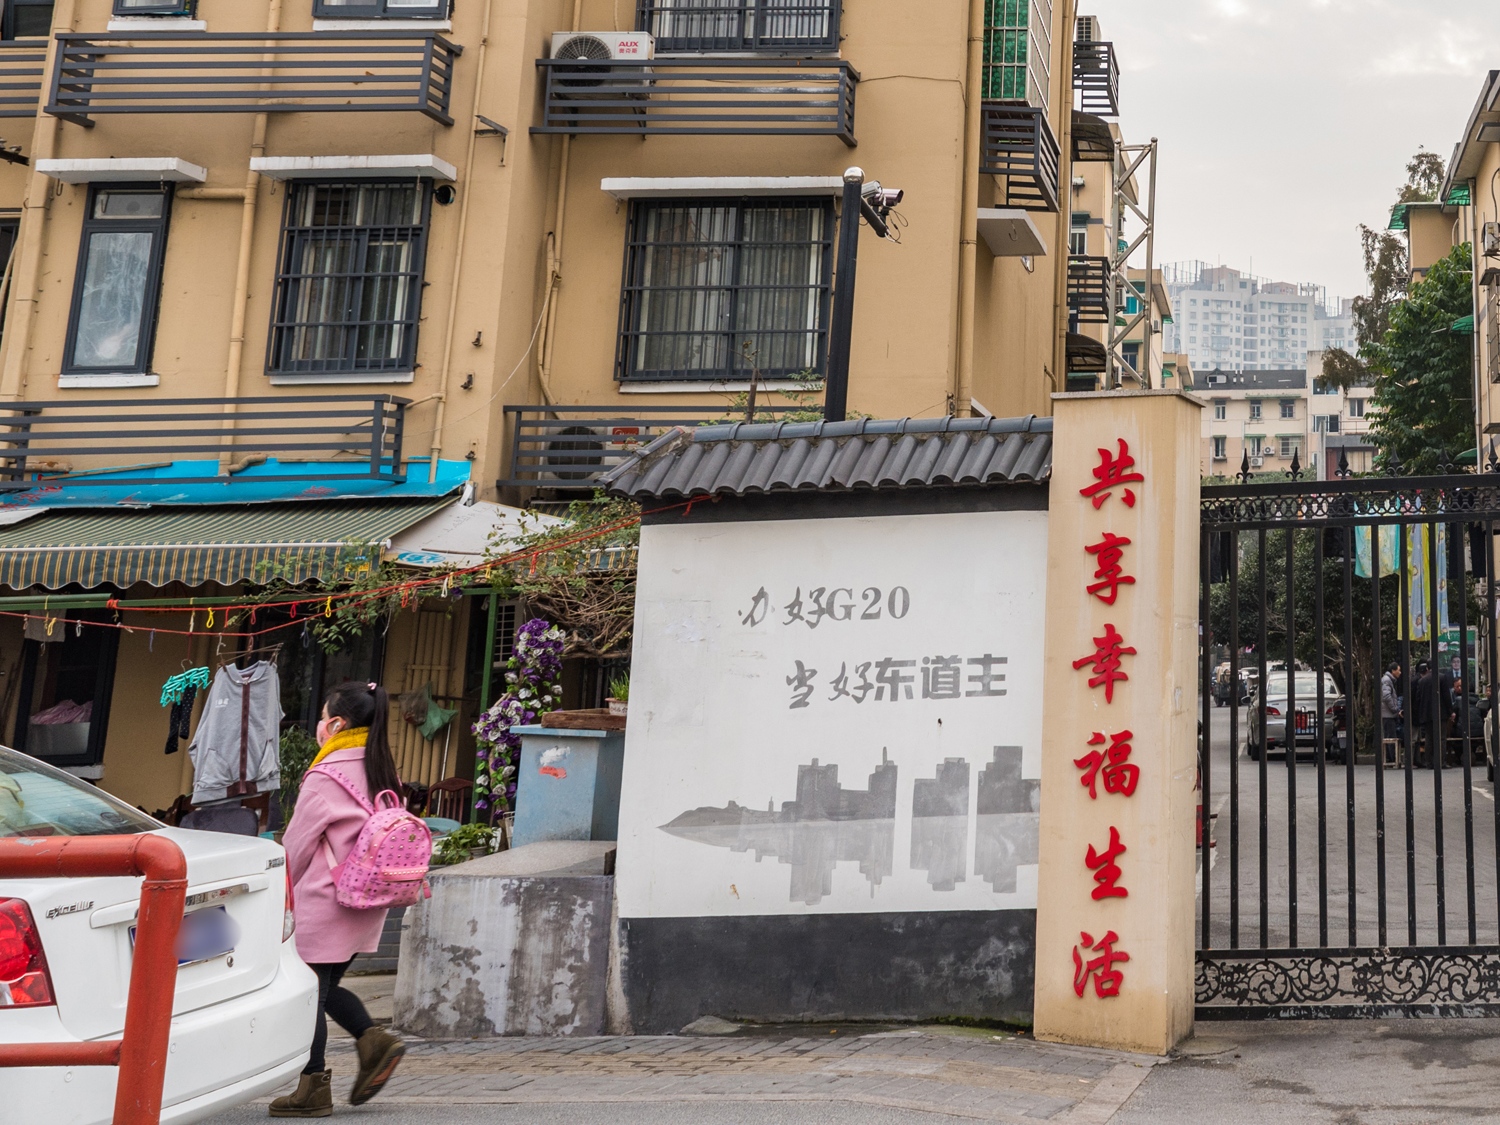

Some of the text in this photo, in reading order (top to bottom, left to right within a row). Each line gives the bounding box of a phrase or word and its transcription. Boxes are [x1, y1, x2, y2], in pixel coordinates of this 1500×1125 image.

[786, 653, 1008, 710] 当好东道主
[1072, 437, 1145, 999] 共享幸福生活
[46, 899, 95, 919] EXCELLE
